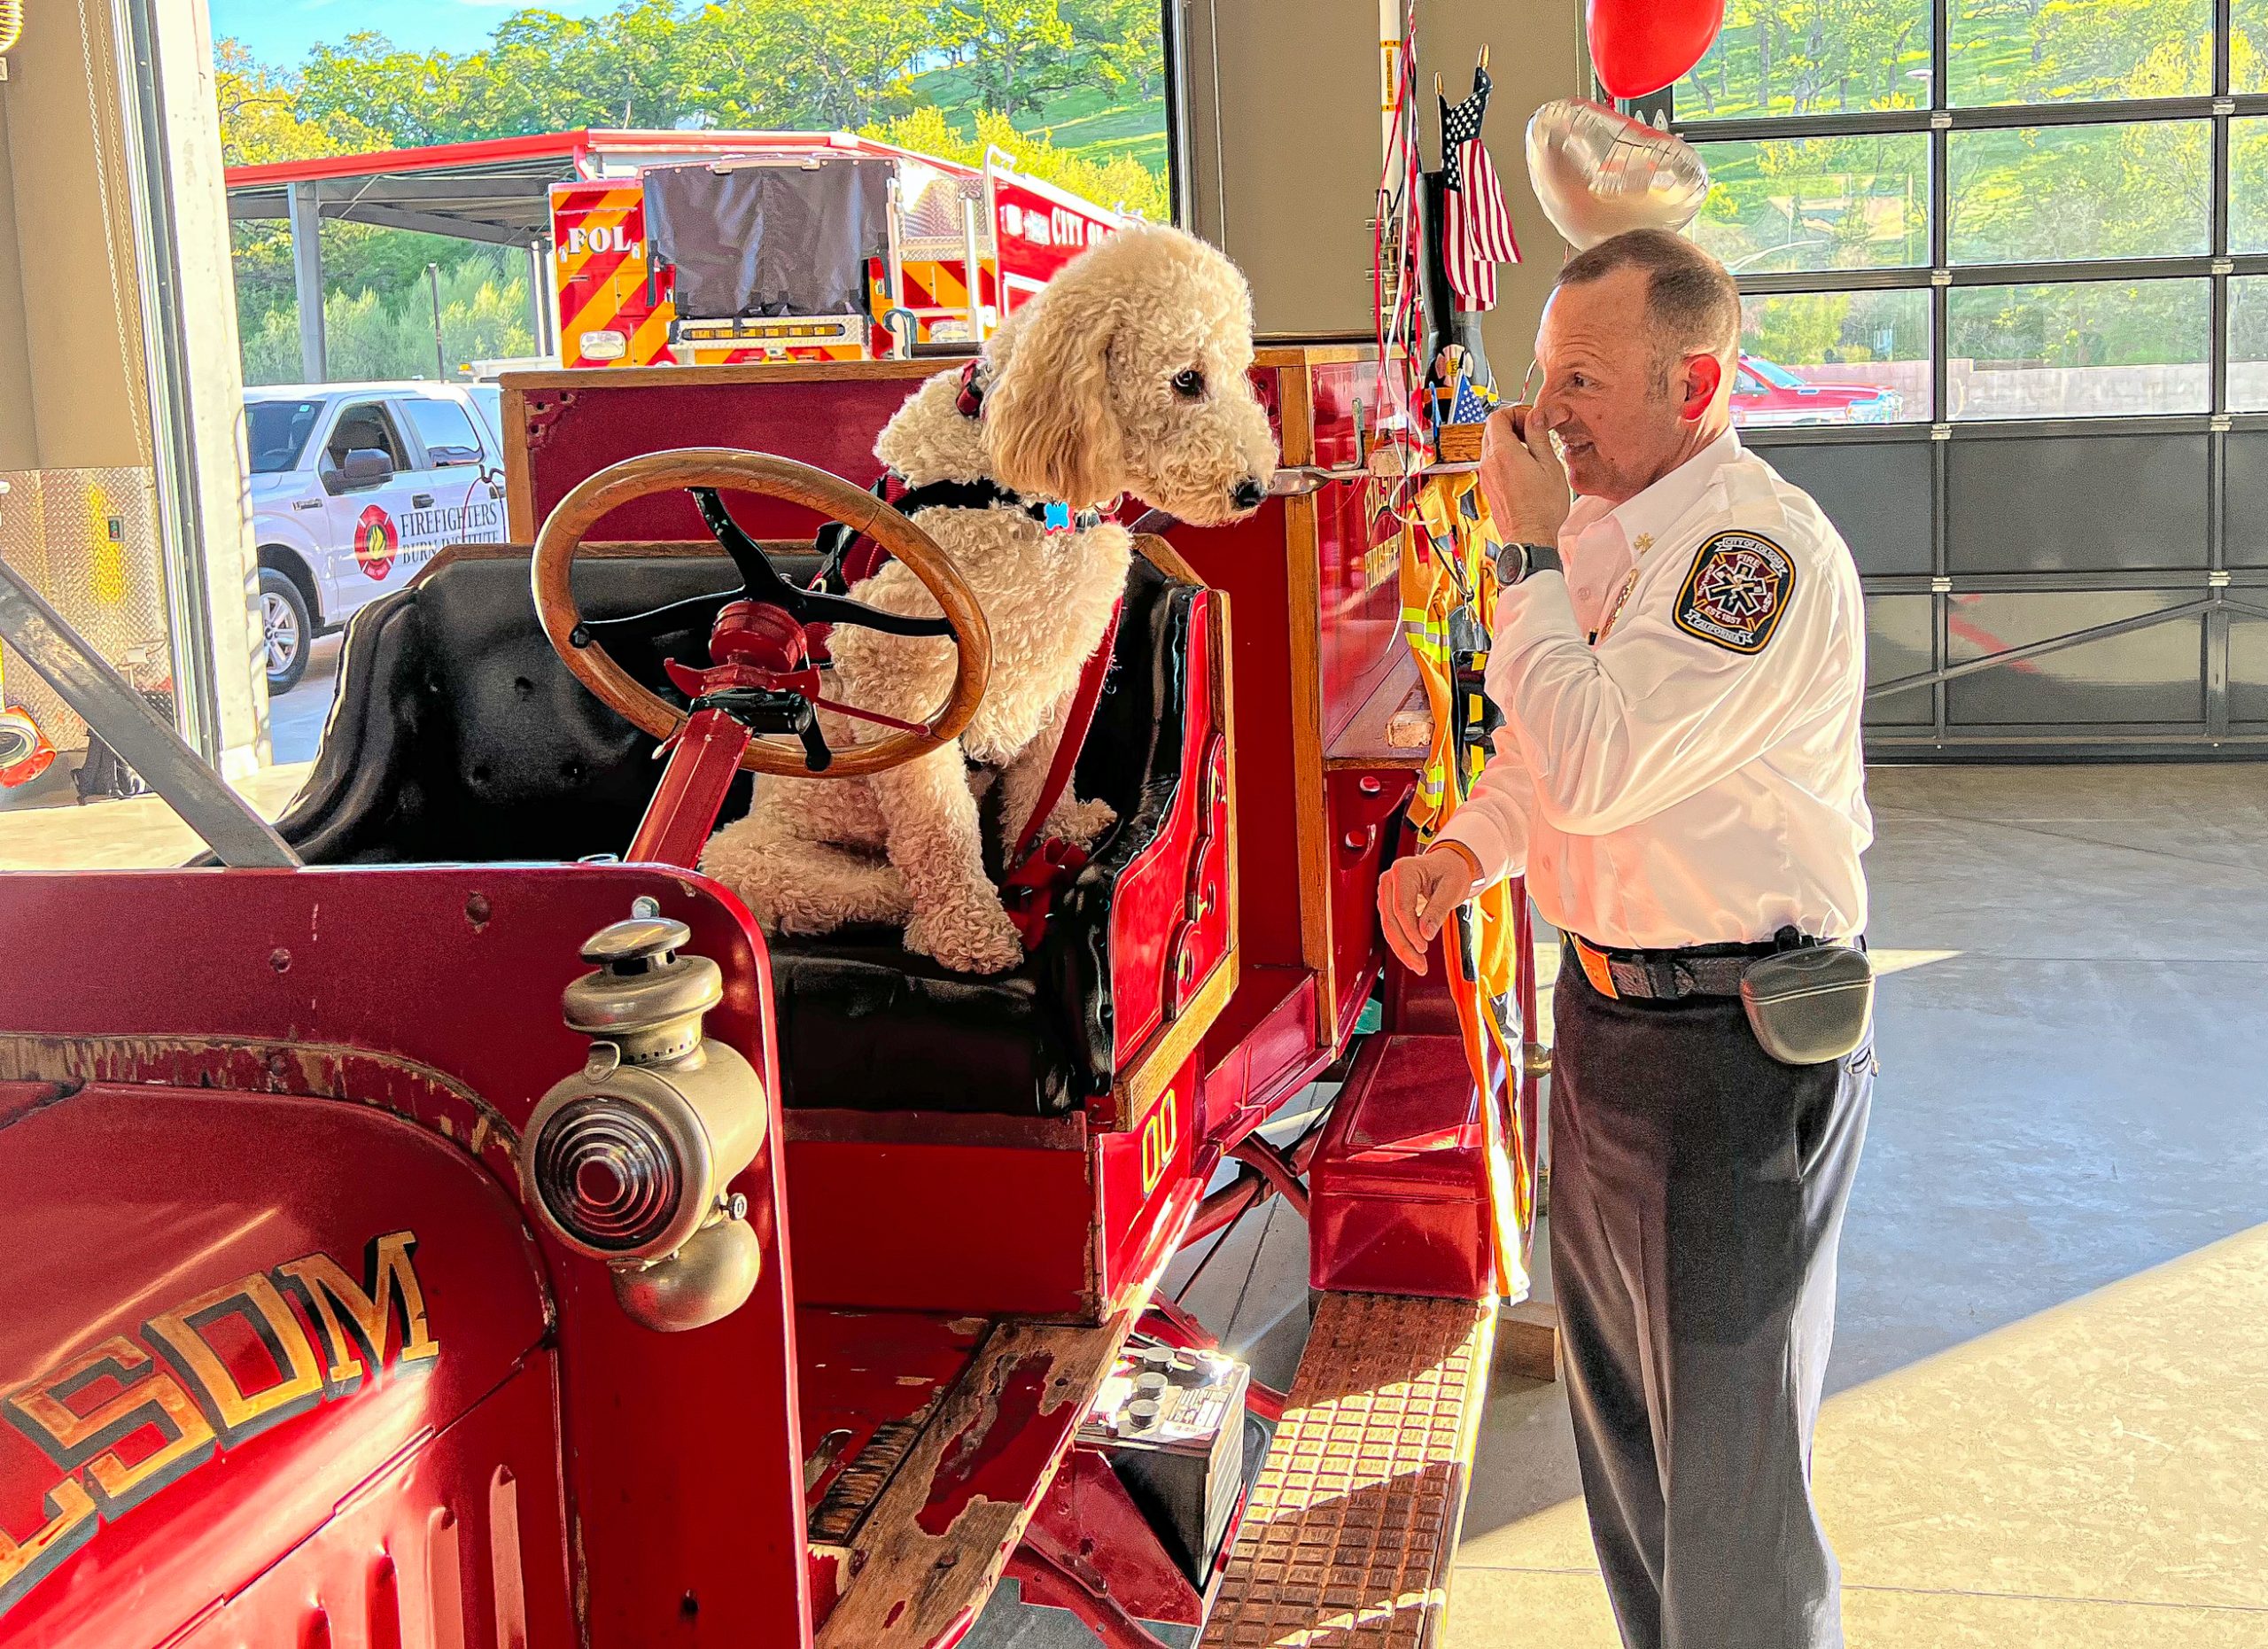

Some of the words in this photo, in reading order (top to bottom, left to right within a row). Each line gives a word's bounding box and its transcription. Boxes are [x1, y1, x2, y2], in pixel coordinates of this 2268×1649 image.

[1051, 206, 1084, 246] CITY
[568, 225, 633, 255] FOL
[400, 502, 497, 539] FIREFIGHTERS
[402, 539, 438, 564] BURN
[1736, 554, 1762, 569] FIRE
[1755, 543, 1784, 567] FOLSOM
[1760, 591, 1774, 613] EMS
[1693, 618, 1741, 642] CALIFORNIA
